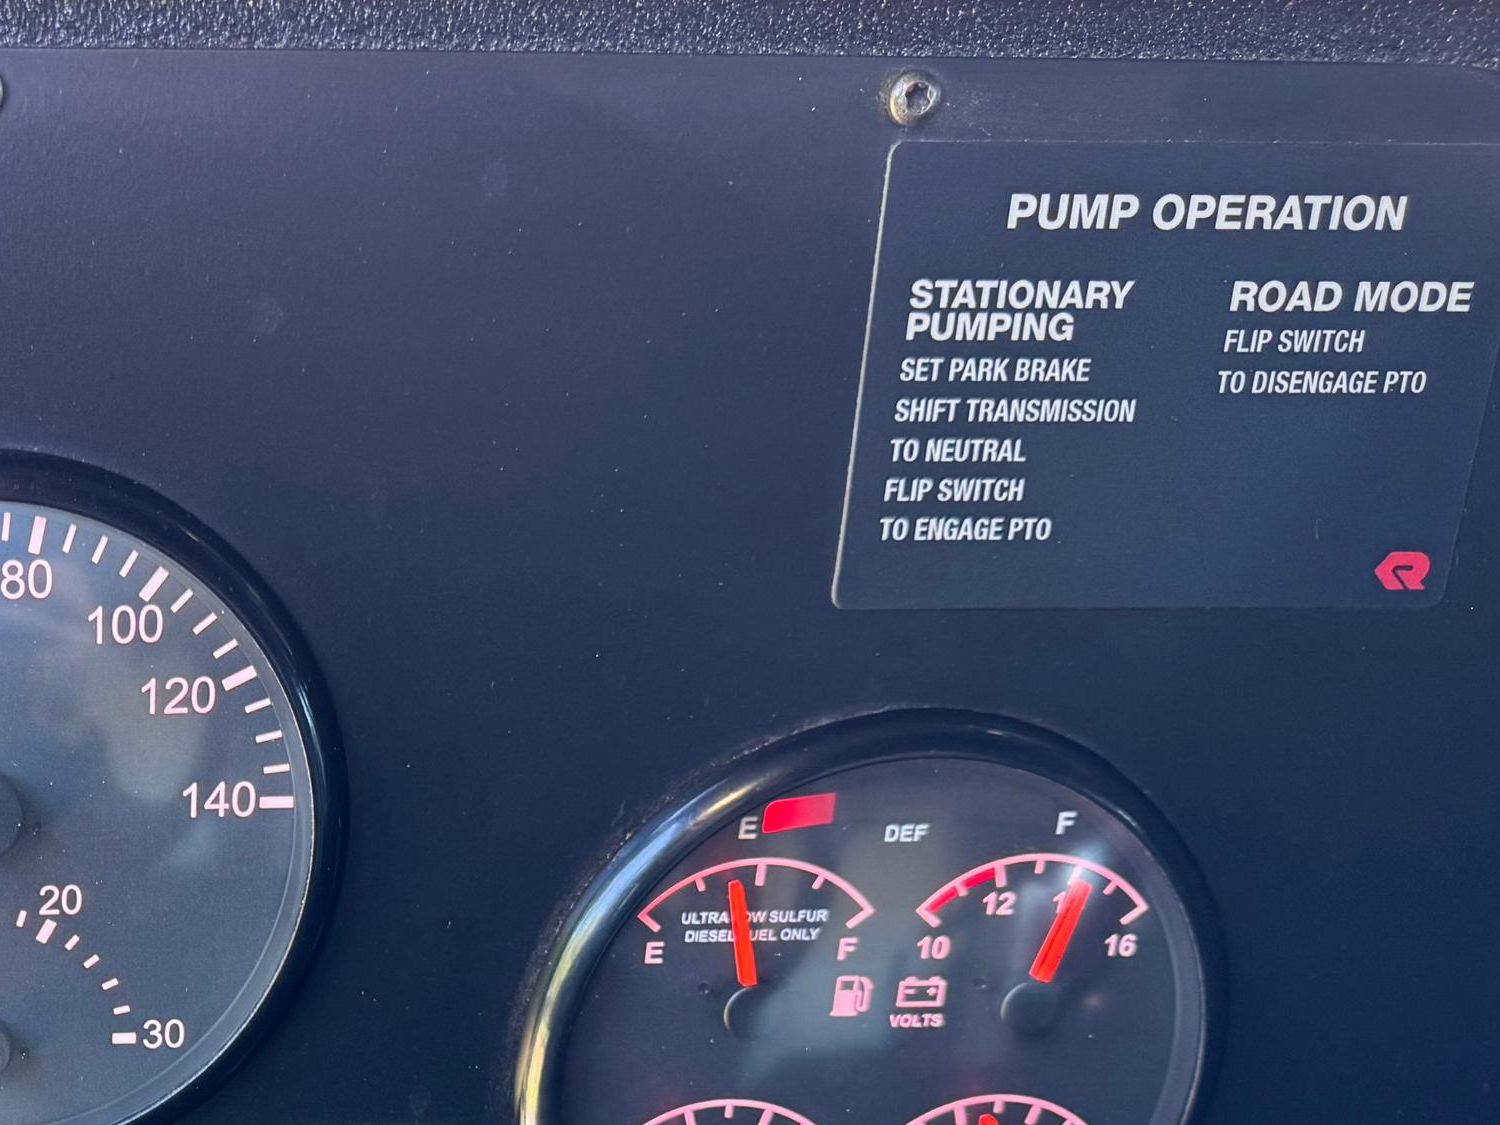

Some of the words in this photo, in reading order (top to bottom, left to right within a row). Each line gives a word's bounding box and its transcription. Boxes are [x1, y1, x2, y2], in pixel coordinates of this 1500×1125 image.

[1007, 193, 1139, 230] PUMP
[1152, 194, 1407, 231] OPERATION
[909, 279, 1135, 309] STATIONARY
[1229, 280, 1343, 312] ROAD
[1353, 281, 1474, 312] MODE
[905, 312, 1075, 341] PUMPING
[1223, 329, 1272, 353] FLIP
[1278, 329, 1365, 353] SWITCH
[900, 358, 945, 382] SET
[948, 358, 1009, 382] PARK
[1014, 358, 1091, 382] BRAKE
[1218, 371, 1246, 394] TO
[1251, 371, 1379, 394] DISENGAGE
[1383, 371, 1427, 394] PTO
[894, 399, 962, 423] SHIFT
[966, 399, 1136, 423] TRANSMISSION
[890, 439, 919, 462] TO
[924, 439, 1026, 462] NEUTRAL
[883, 479, 933, 502] FLIP
[937, 479, 1025, 502] SWITCH
[880, 518, 909, 541] TO
[914, 518, 1004, 541] ENGAGE
[1008, 518, 1052, 541] PTO
[0, 558, 53, 600] 80
[88, 604, 163, 646] 100
[140, 676, 216, 716] 120
[182, 780, 257, 819] 140
[738, 816, 758, 840] E
[884, 823, 931, 843] DEF
[1055, 811, 1078, 835] F
[39, 884, 83, 916] 20
[982, 892, 1016, 916] 12
[681, 910, 729, 925] ULTRA
[768, 909, 829, 923] SULFUR
[684, 928, 736, 943] DIESEL
[749, 929, 777, 942] UEL
[780, 927, 821, 941] ONLY
[1104, 934, 1138, 958] 16
[644, 941, 665, 964] E
[837, 937, 859, 961] F
[917, 936, 951, 960] 10
[889, 1014, 945, 1028] VOLTS
[142, 1019, 185, 1049] 30
